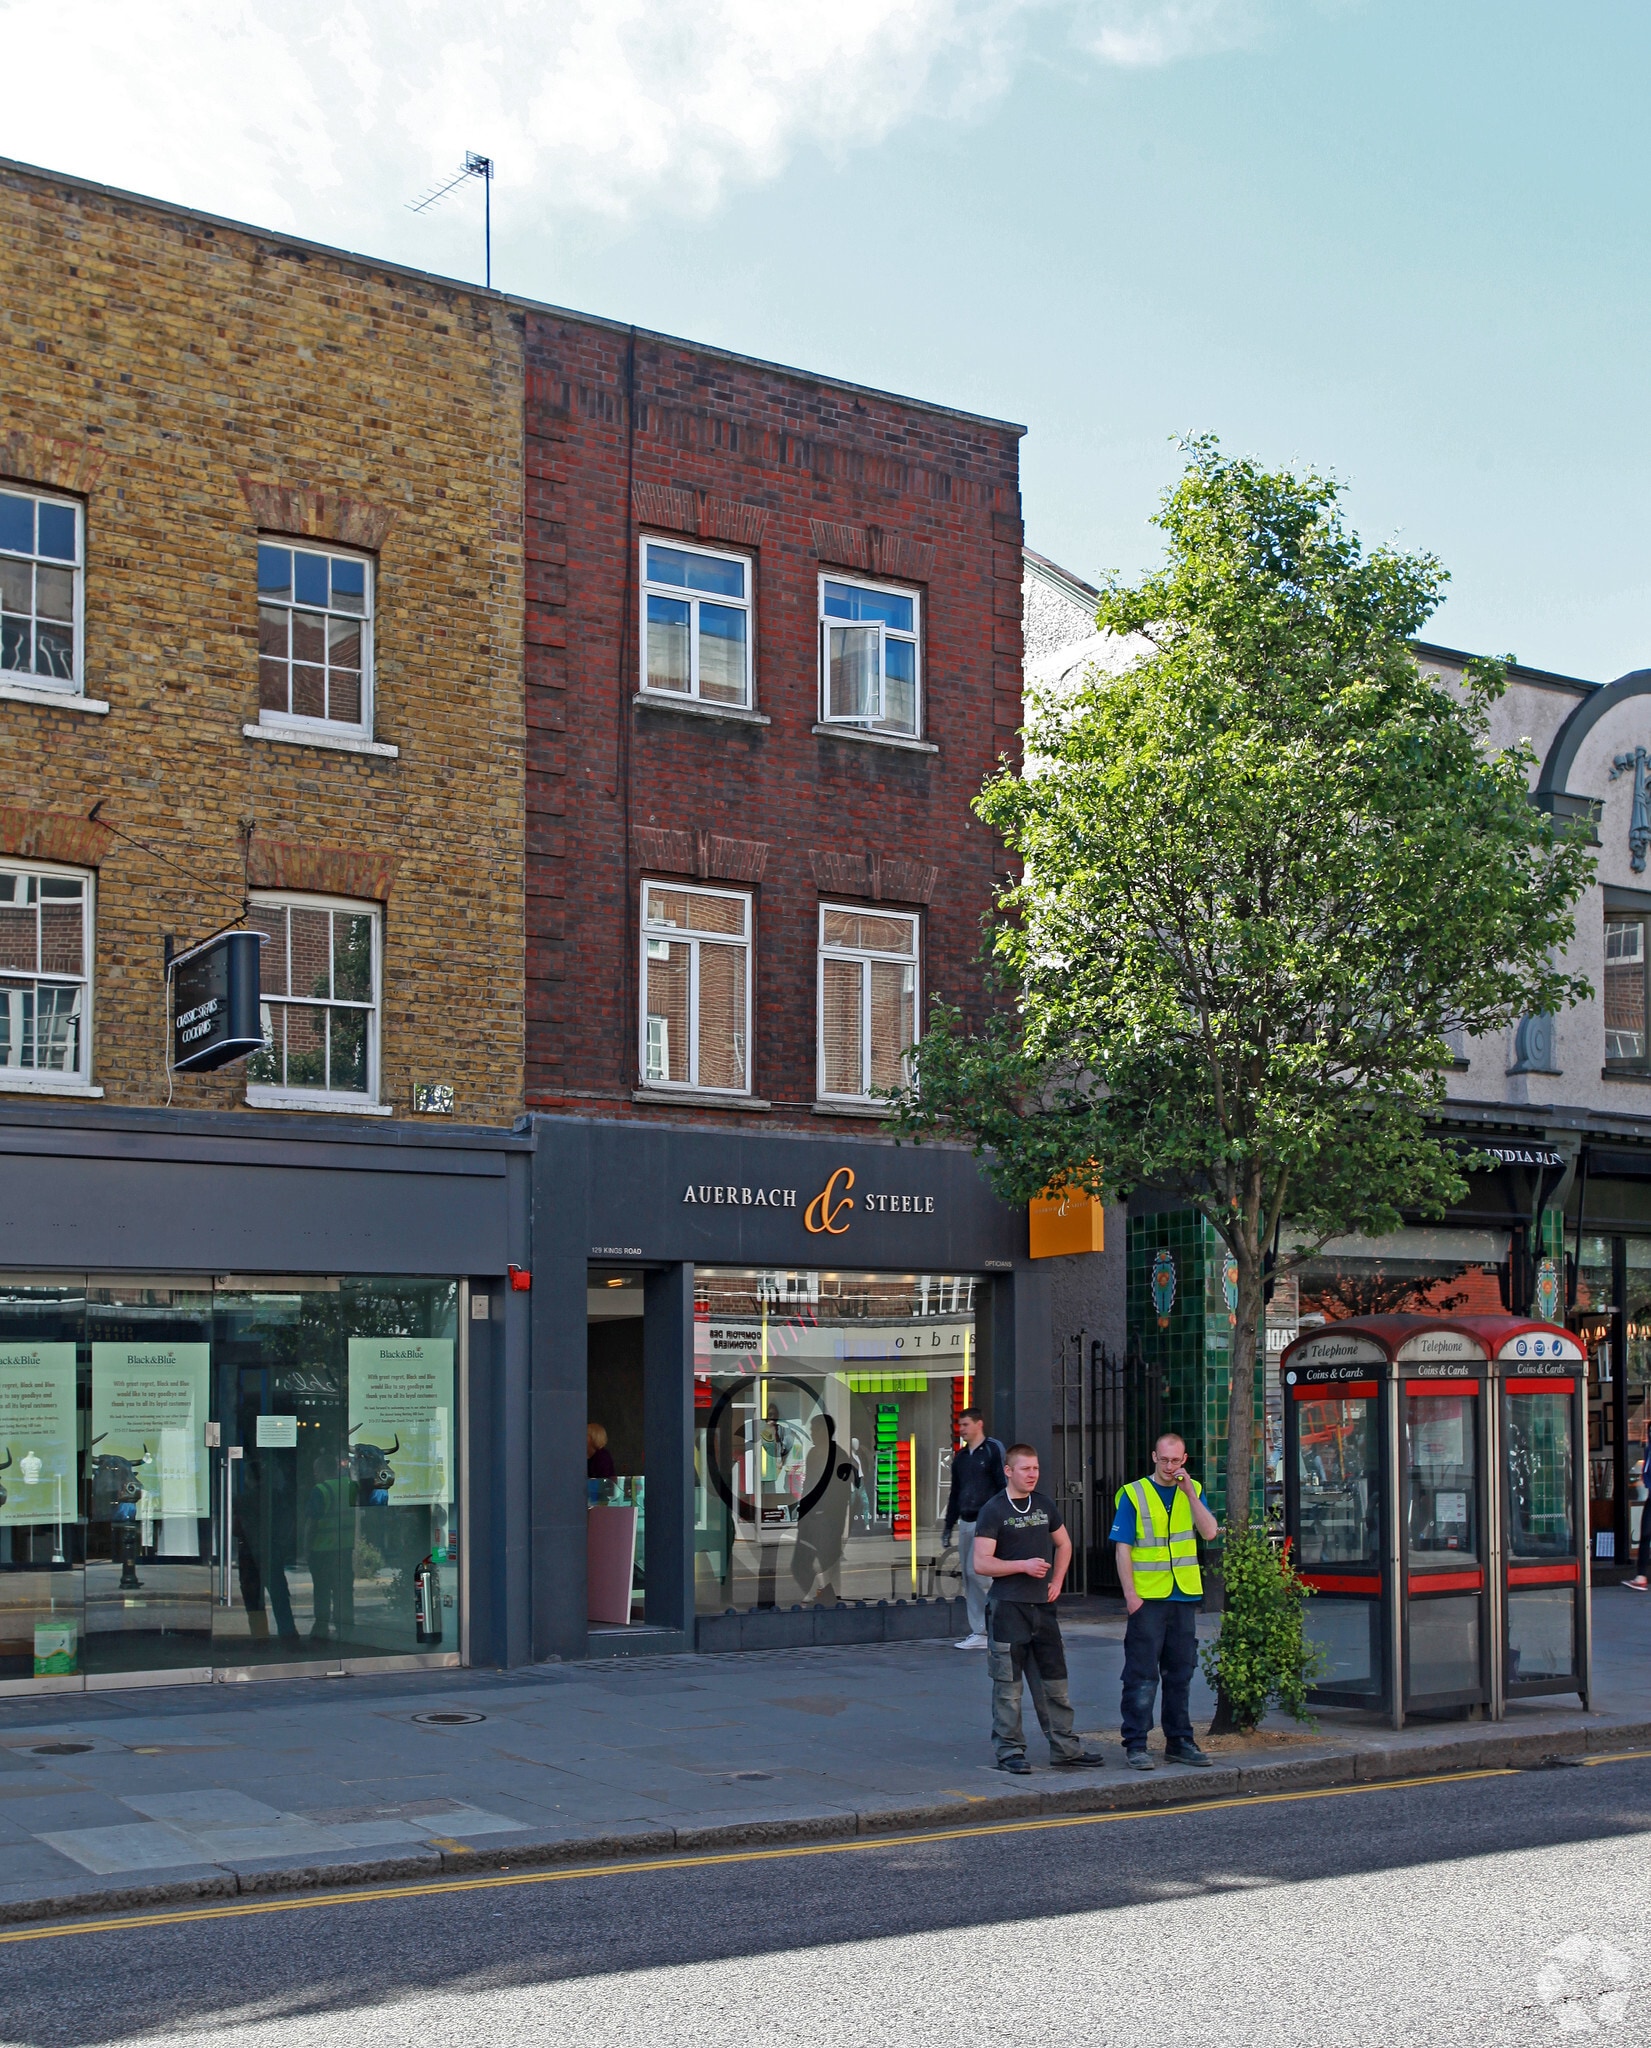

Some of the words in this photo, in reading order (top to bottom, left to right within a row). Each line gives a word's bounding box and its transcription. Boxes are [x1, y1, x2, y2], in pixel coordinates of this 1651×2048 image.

[1485, 1149, 1534, 1163] INDIA
[683, 1185, 797, 1207] AUERBACH
[804, 1167, 855, 1234] &
[865, 1194, 935, 1213] STEELE
[603, 1247, 622, 1255] KINGS
[624, 1247, 642, 1255] ROAD
[984, 1260, 1013, 1268] OPTICIANS
[1311, 1344, 1359, 1358] Telephone
[1421, 1340, 1462, 1354] Telephone
[380, 1350, 424, 1358] Black&Blue
[0, 1356, 40, 1365] ack&Blue
[127, 1355, 176, 1364] Black&Blue
[1306, 1369, 1329, 1380] Coins
[1330, 1368, 1337, 1378] &
[1340, 1367, 1364, 1378] Cards
[1418, 1365, 1438, 1375] Coins
[1439, 1365, 1447, 1375] &
[1448, 1365, 1468, 1375] Cards
[1517, 1364, 1536, 1374] Coins
[1537, 1364, 1544, 1374] &
[1545, 1364, 1565, 1374] Cards
